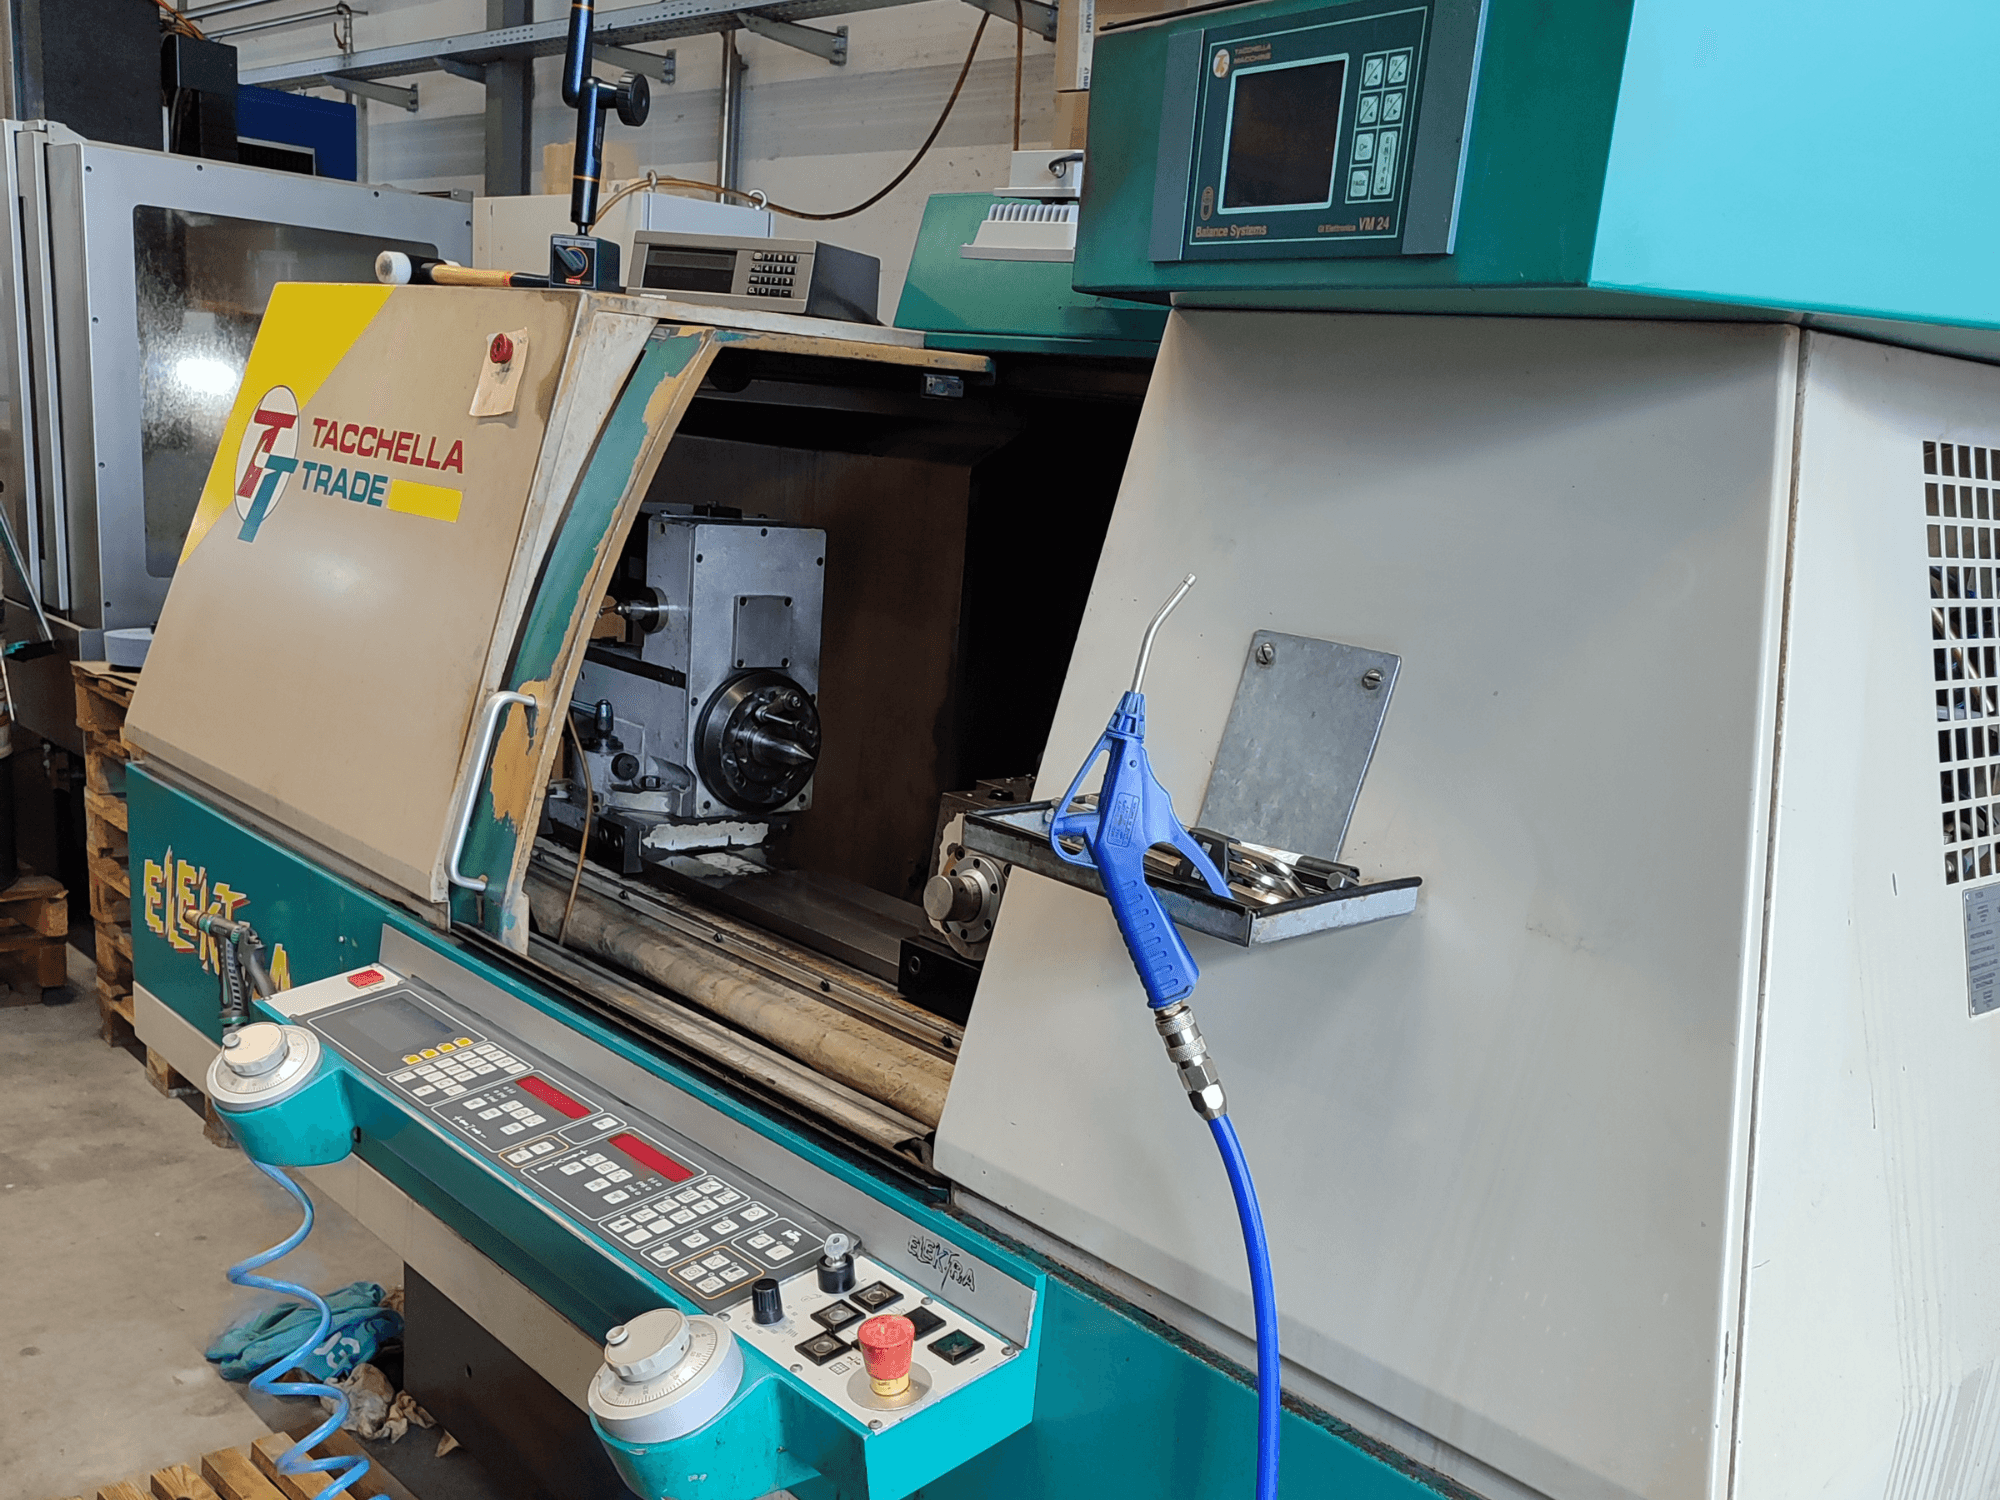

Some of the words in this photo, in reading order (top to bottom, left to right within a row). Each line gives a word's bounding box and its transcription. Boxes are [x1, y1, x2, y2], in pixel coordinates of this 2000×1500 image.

[1195, 226, 1229, 238] Balance
[1230, 223, 1268, 239] Systems
[1359, 217, 1376, 231] VM
[1376, 216, 1390, 231] 24
[312, 417, 464, 474] TACCHELLA
[302, 460, 389, 507] TRADE
[907, 1235, 975, 1292] ELEKTRA
